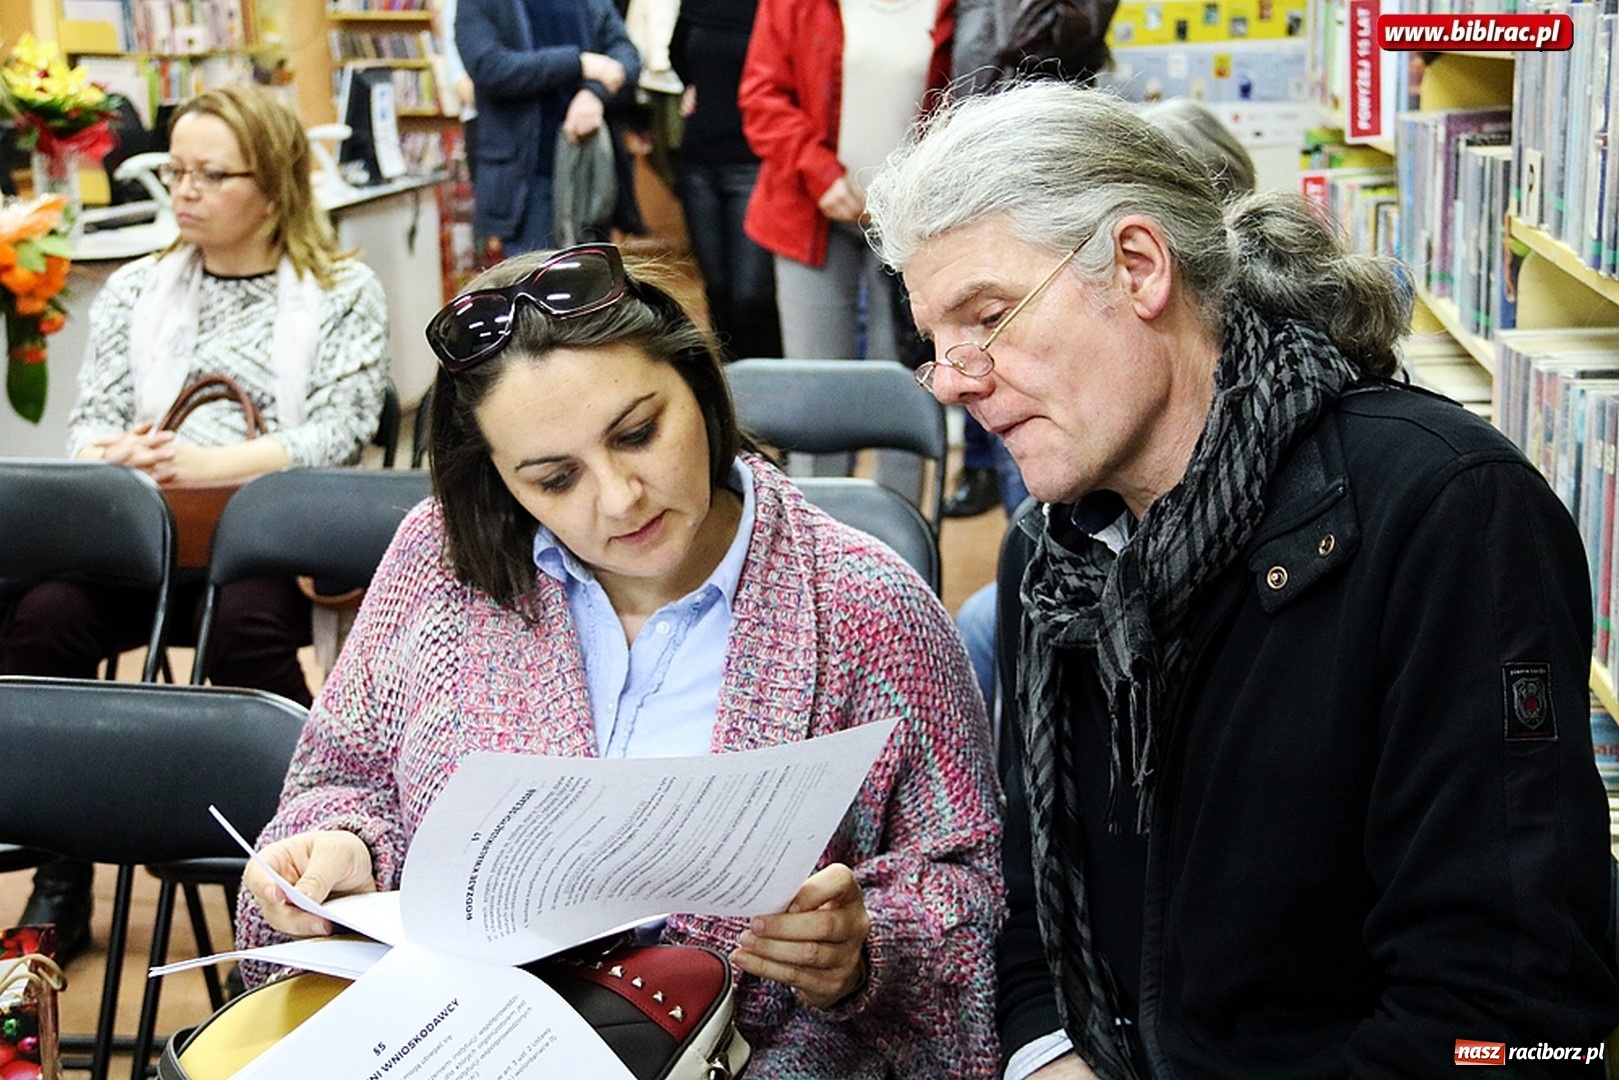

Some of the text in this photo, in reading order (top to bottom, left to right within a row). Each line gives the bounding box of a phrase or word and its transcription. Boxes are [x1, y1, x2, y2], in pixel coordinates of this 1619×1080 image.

[1356, 7, 1372, 37] LAT
[465, 874, 478, 921] RODZAJE
[373, 1041, 386, 1056] §5
[381, 997, 459, 1072] WNIOSKODAWCY
